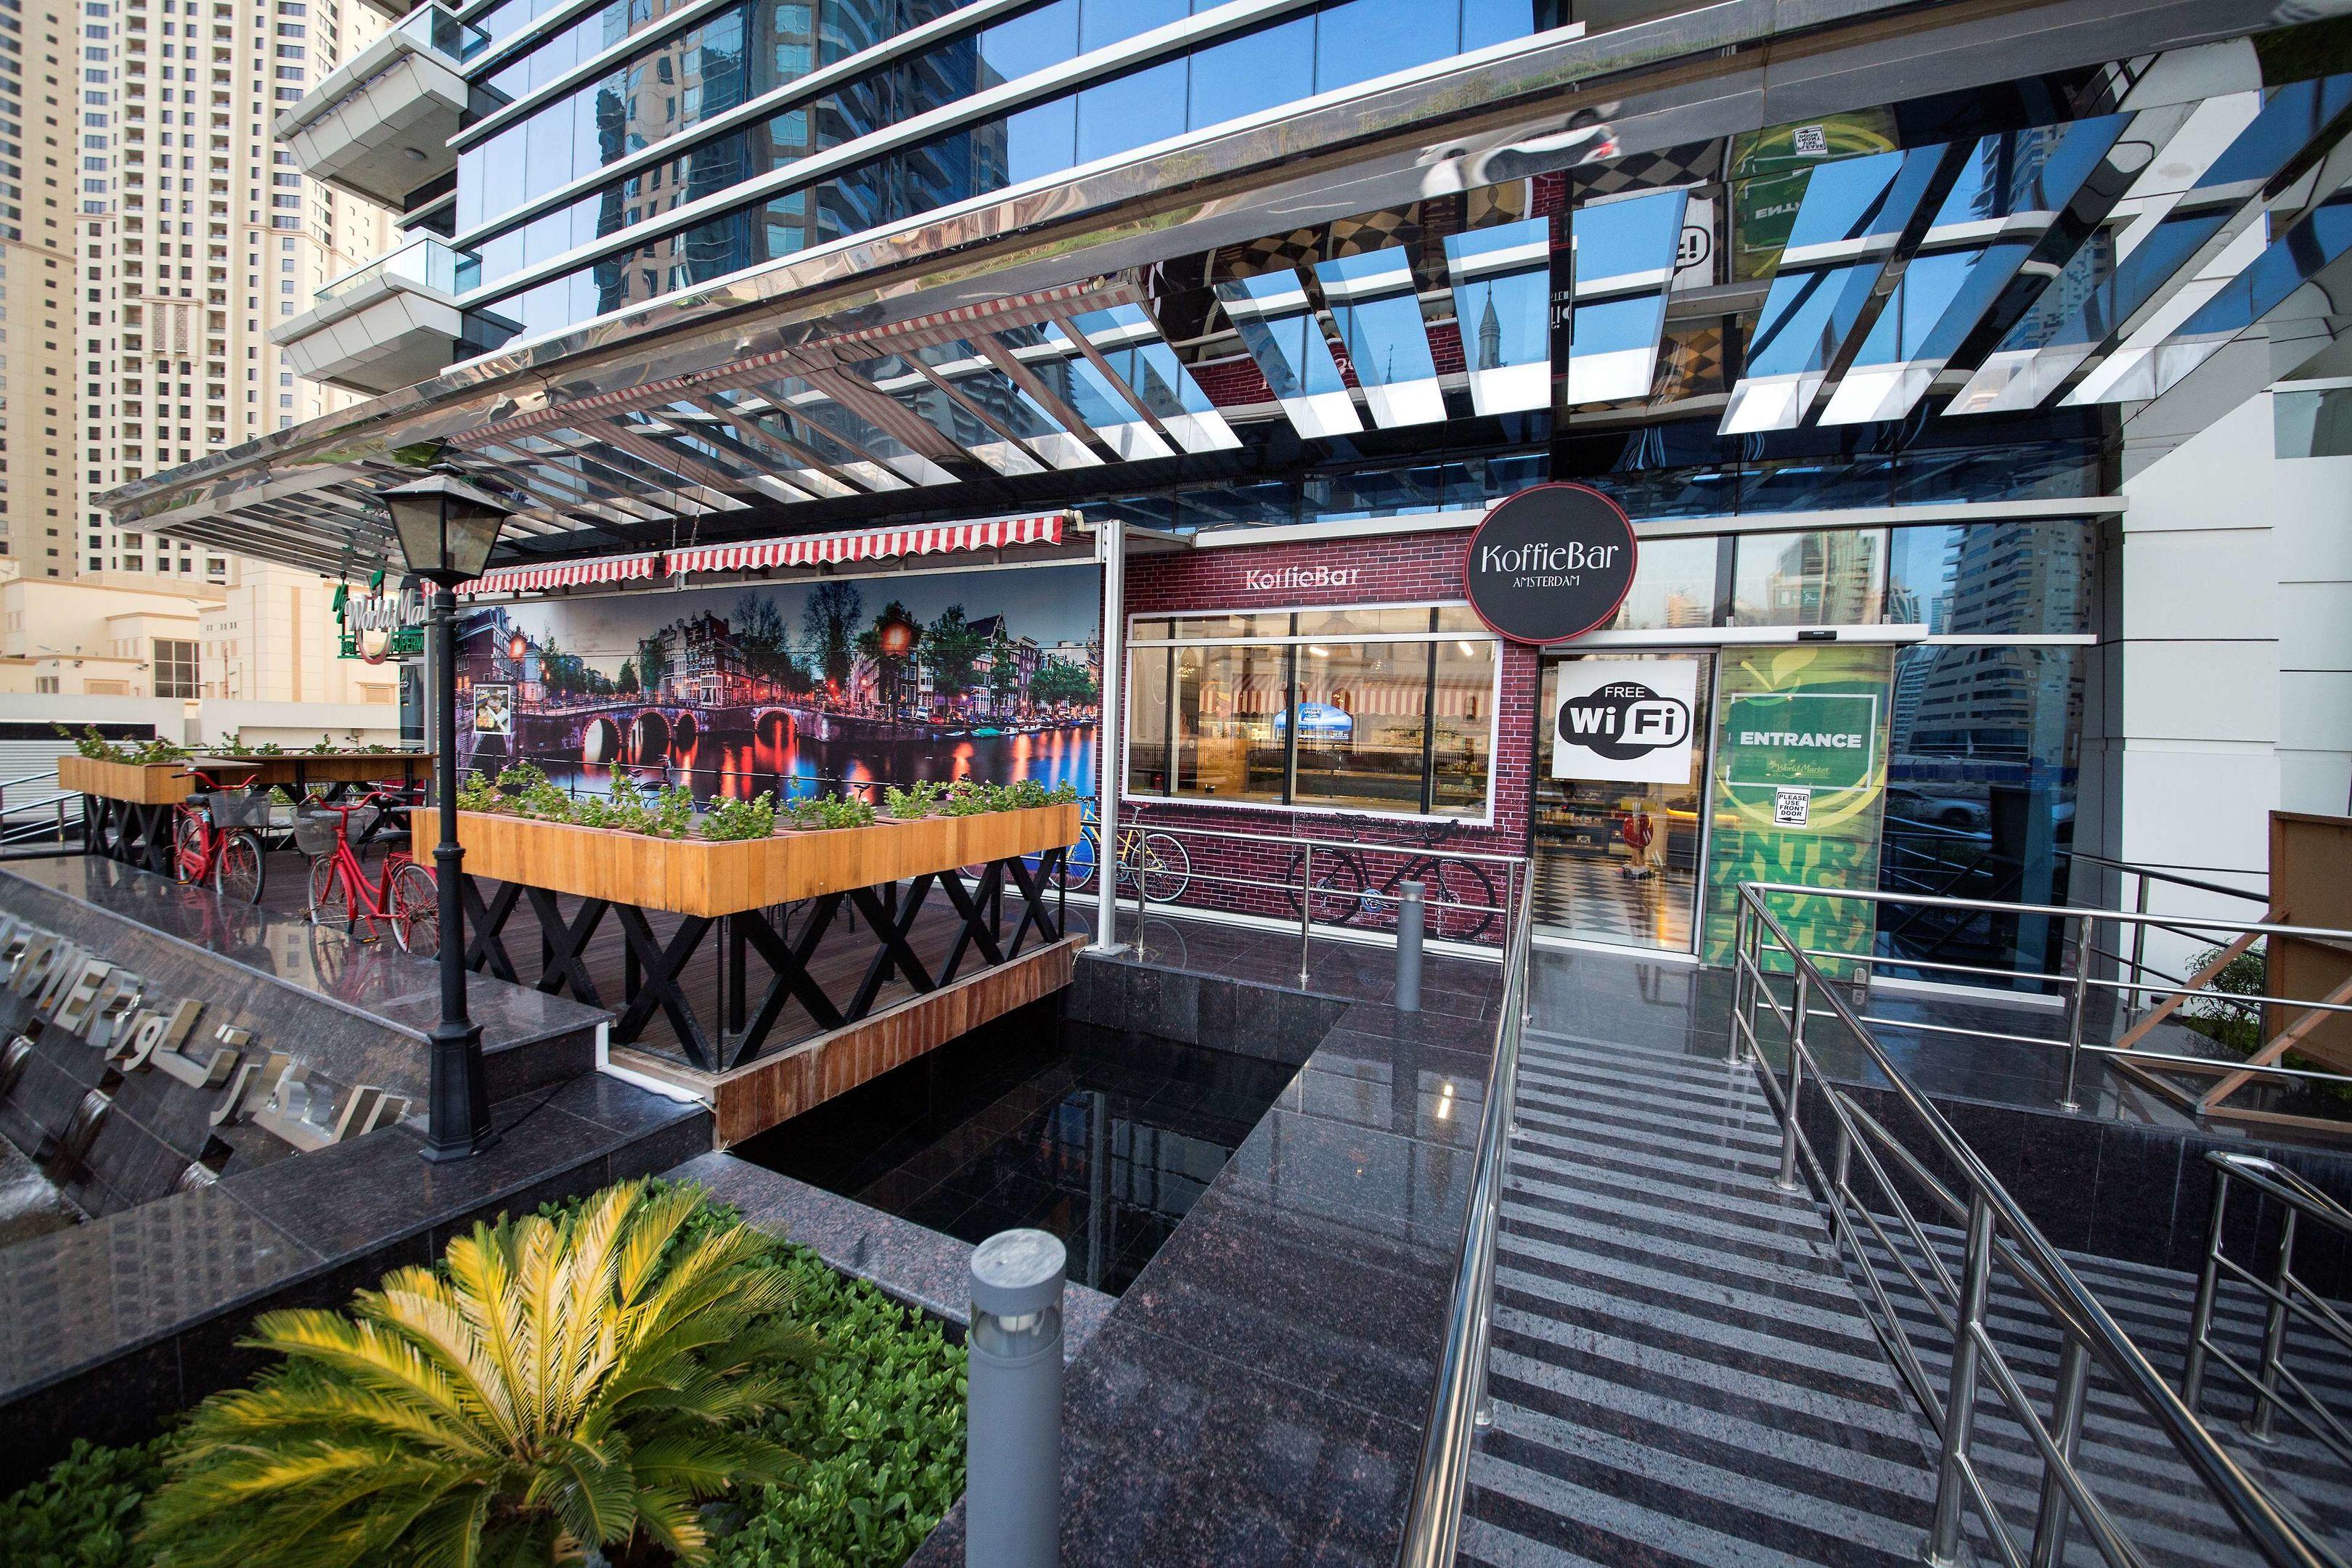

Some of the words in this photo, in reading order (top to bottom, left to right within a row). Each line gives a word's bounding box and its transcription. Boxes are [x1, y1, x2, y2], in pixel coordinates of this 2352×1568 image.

[1481, 541, 1620, 573] KoffieBar
[1244, 565, 1361, 590] KoffieBar
[1512, 575, 1580, 588] AMSTERDAM
[344, 594, 394, 631] World
[392, 636, 425, 652] SUPERM
[1604, 686, 1646, 698] FREE
[1569, 706, 1617, 735] Wi
[1634, 707, 1675, 735] Fi
[1740, 731, 1862, 748] ENTRANCE
